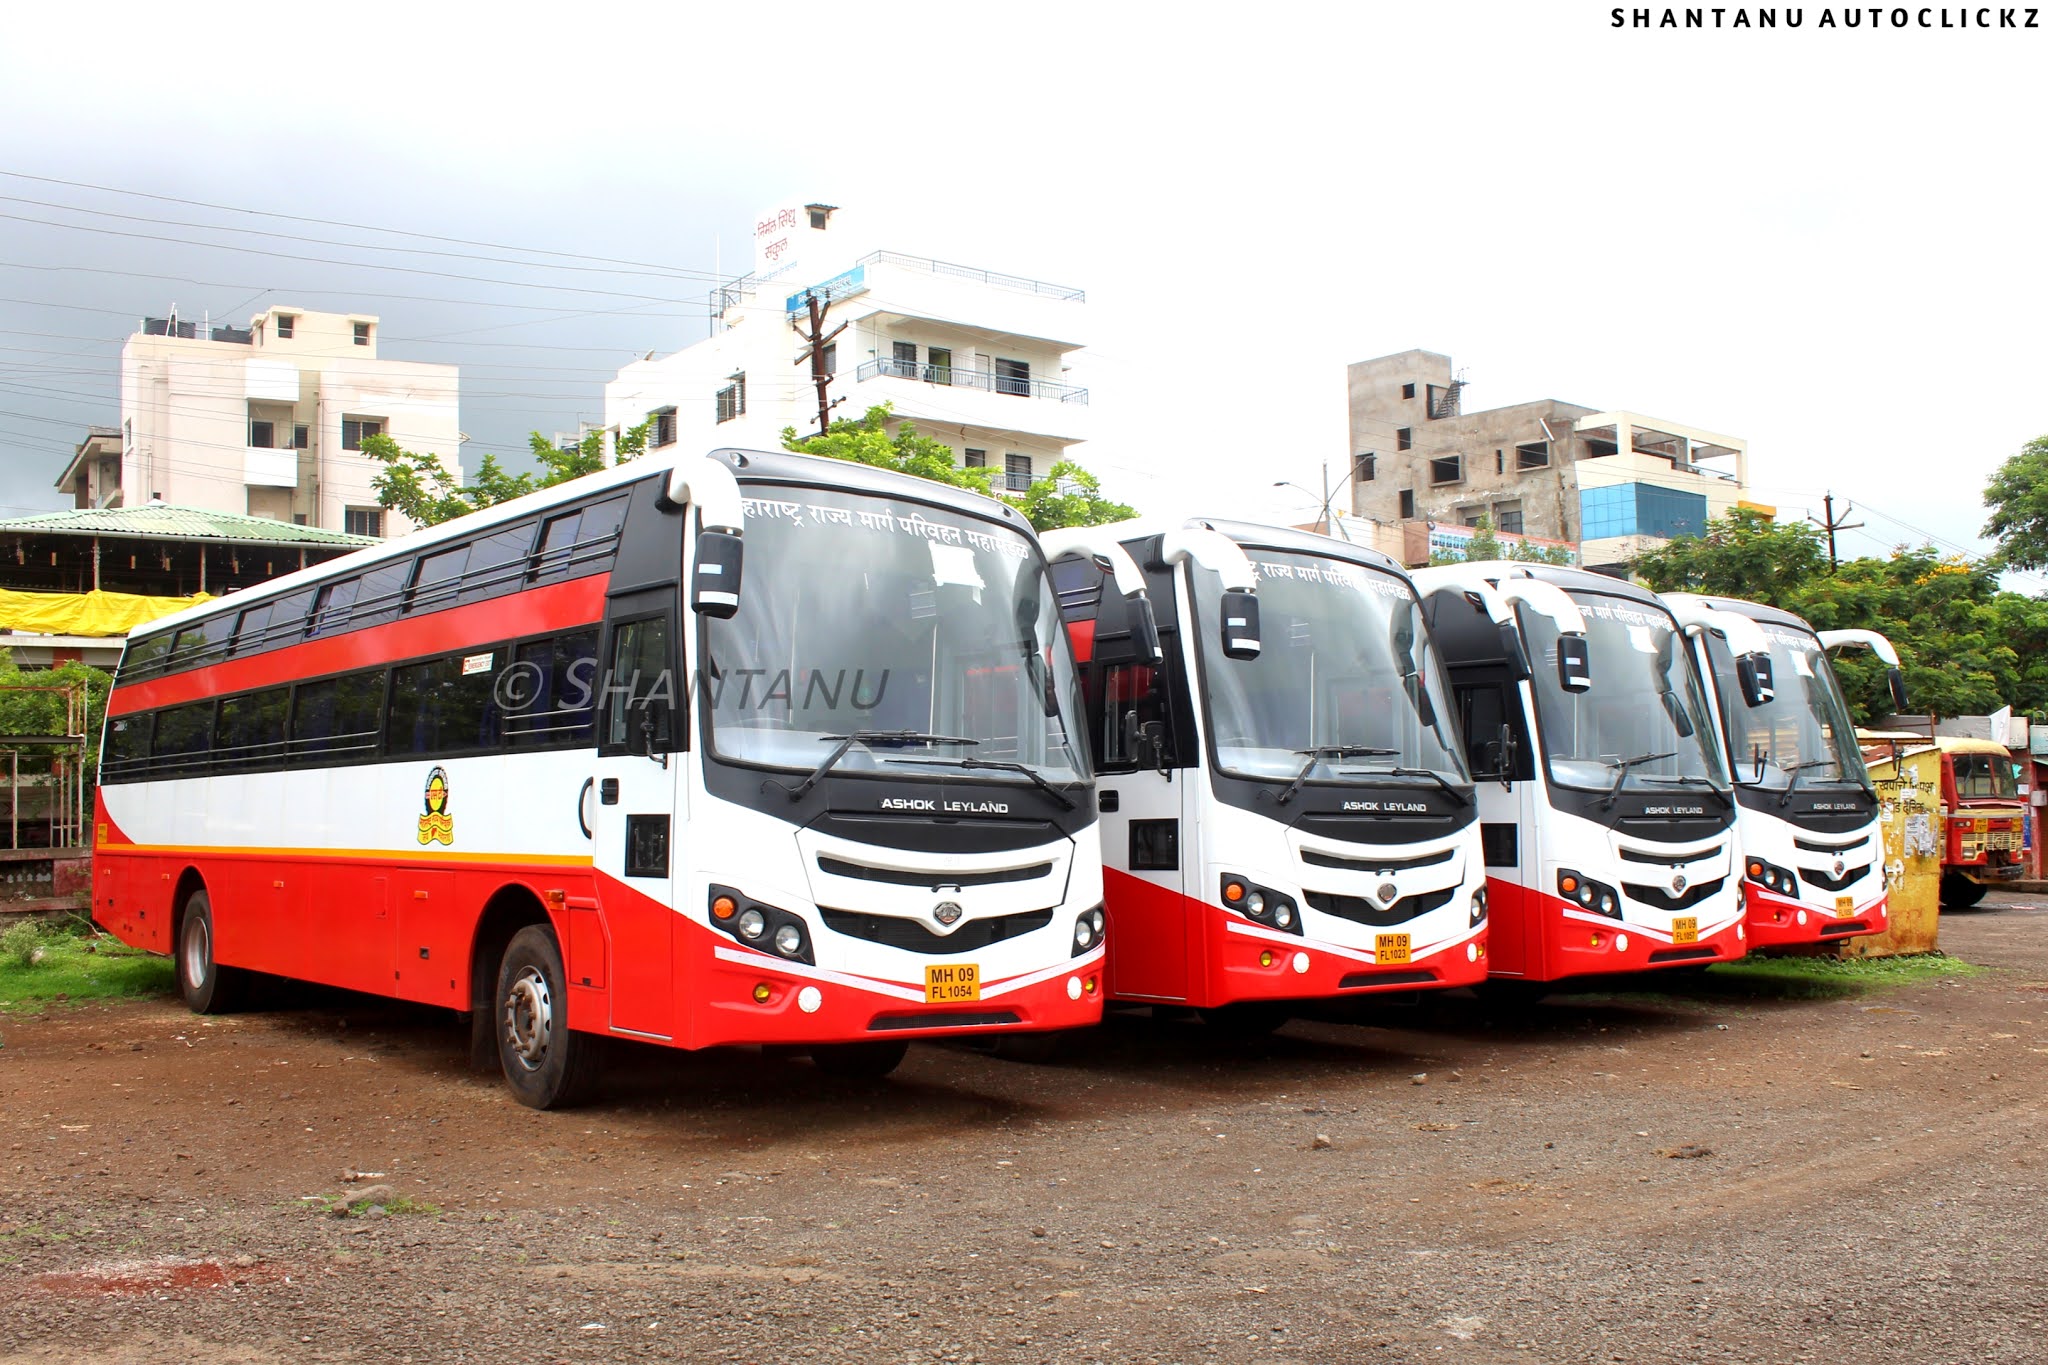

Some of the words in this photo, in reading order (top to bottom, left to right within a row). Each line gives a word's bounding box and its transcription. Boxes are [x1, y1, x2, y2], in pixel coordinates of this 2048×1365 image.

[741, 498, 804, 527] हाराष्ट्र
[808, 504, 852, 526] राज्य
[856, 508, 894, 533] मार्ग
[897, 513, 962, 544] परिवहन
[1261, 562, 1294, 580] राज्य
[1296, 563, 1322, 583] मार्ग
[881, 798, 935, 811] ASHOK
[943, 800, 1009, 814] LEYLAND
[1343, 801, 1379, 811] ASHOK
[1384, 803, 1427, 812] LEYLAND
[1645, 806, 1671, 815] ASHOK
[1673, 806, 1703, 815] LEYLAND
[1675, 919, 1687, 930] MH
[1379, 935, 1394, 948] MH
[1396, 935, 1407, 947] 09
[931, 968, 954, 983] MH
[958, 967, 974, 982] 09
